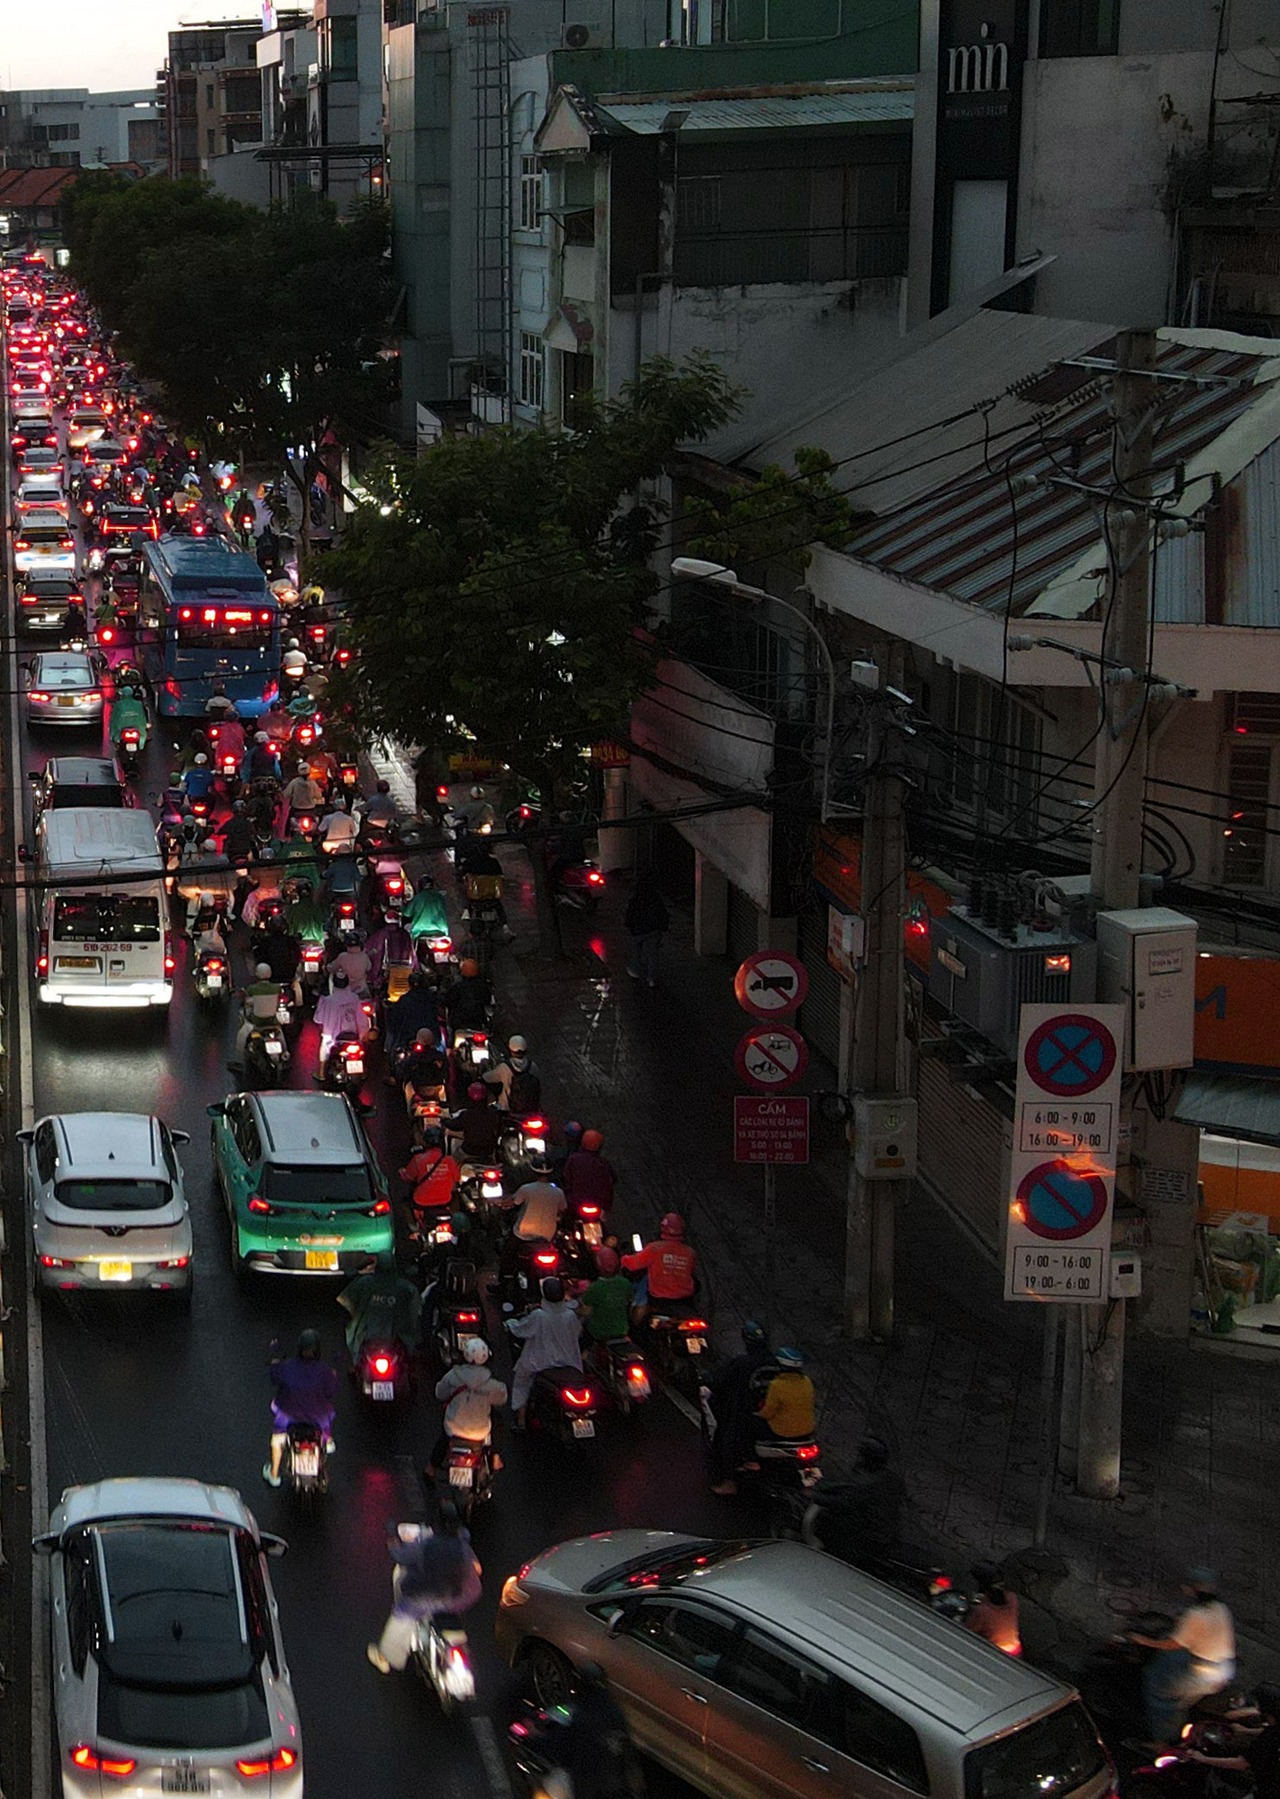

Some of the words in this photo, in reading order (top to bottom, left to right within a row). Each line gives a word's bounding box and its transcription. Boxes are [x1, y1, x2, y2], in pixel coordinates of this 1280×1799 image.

[945, 22, 1009, 94] min
[758, 1100, 787, 1115] CẤM
[1035, 1111, 1059, 1124] 6:00
[1071, 1111, 1096, 1125] 9:00
[1029, 1133, 1059, 1146] 16:00
[1071, 1133, 1101, 1147] 19:00
[1025, 1255, 1049, 1268] 9:00
[1062, 1255, 1091, 1269] 16:00
[1025, 1276, 1053, 1289] 19:00
[1066, 1277, 1090, 1290] 6:00
